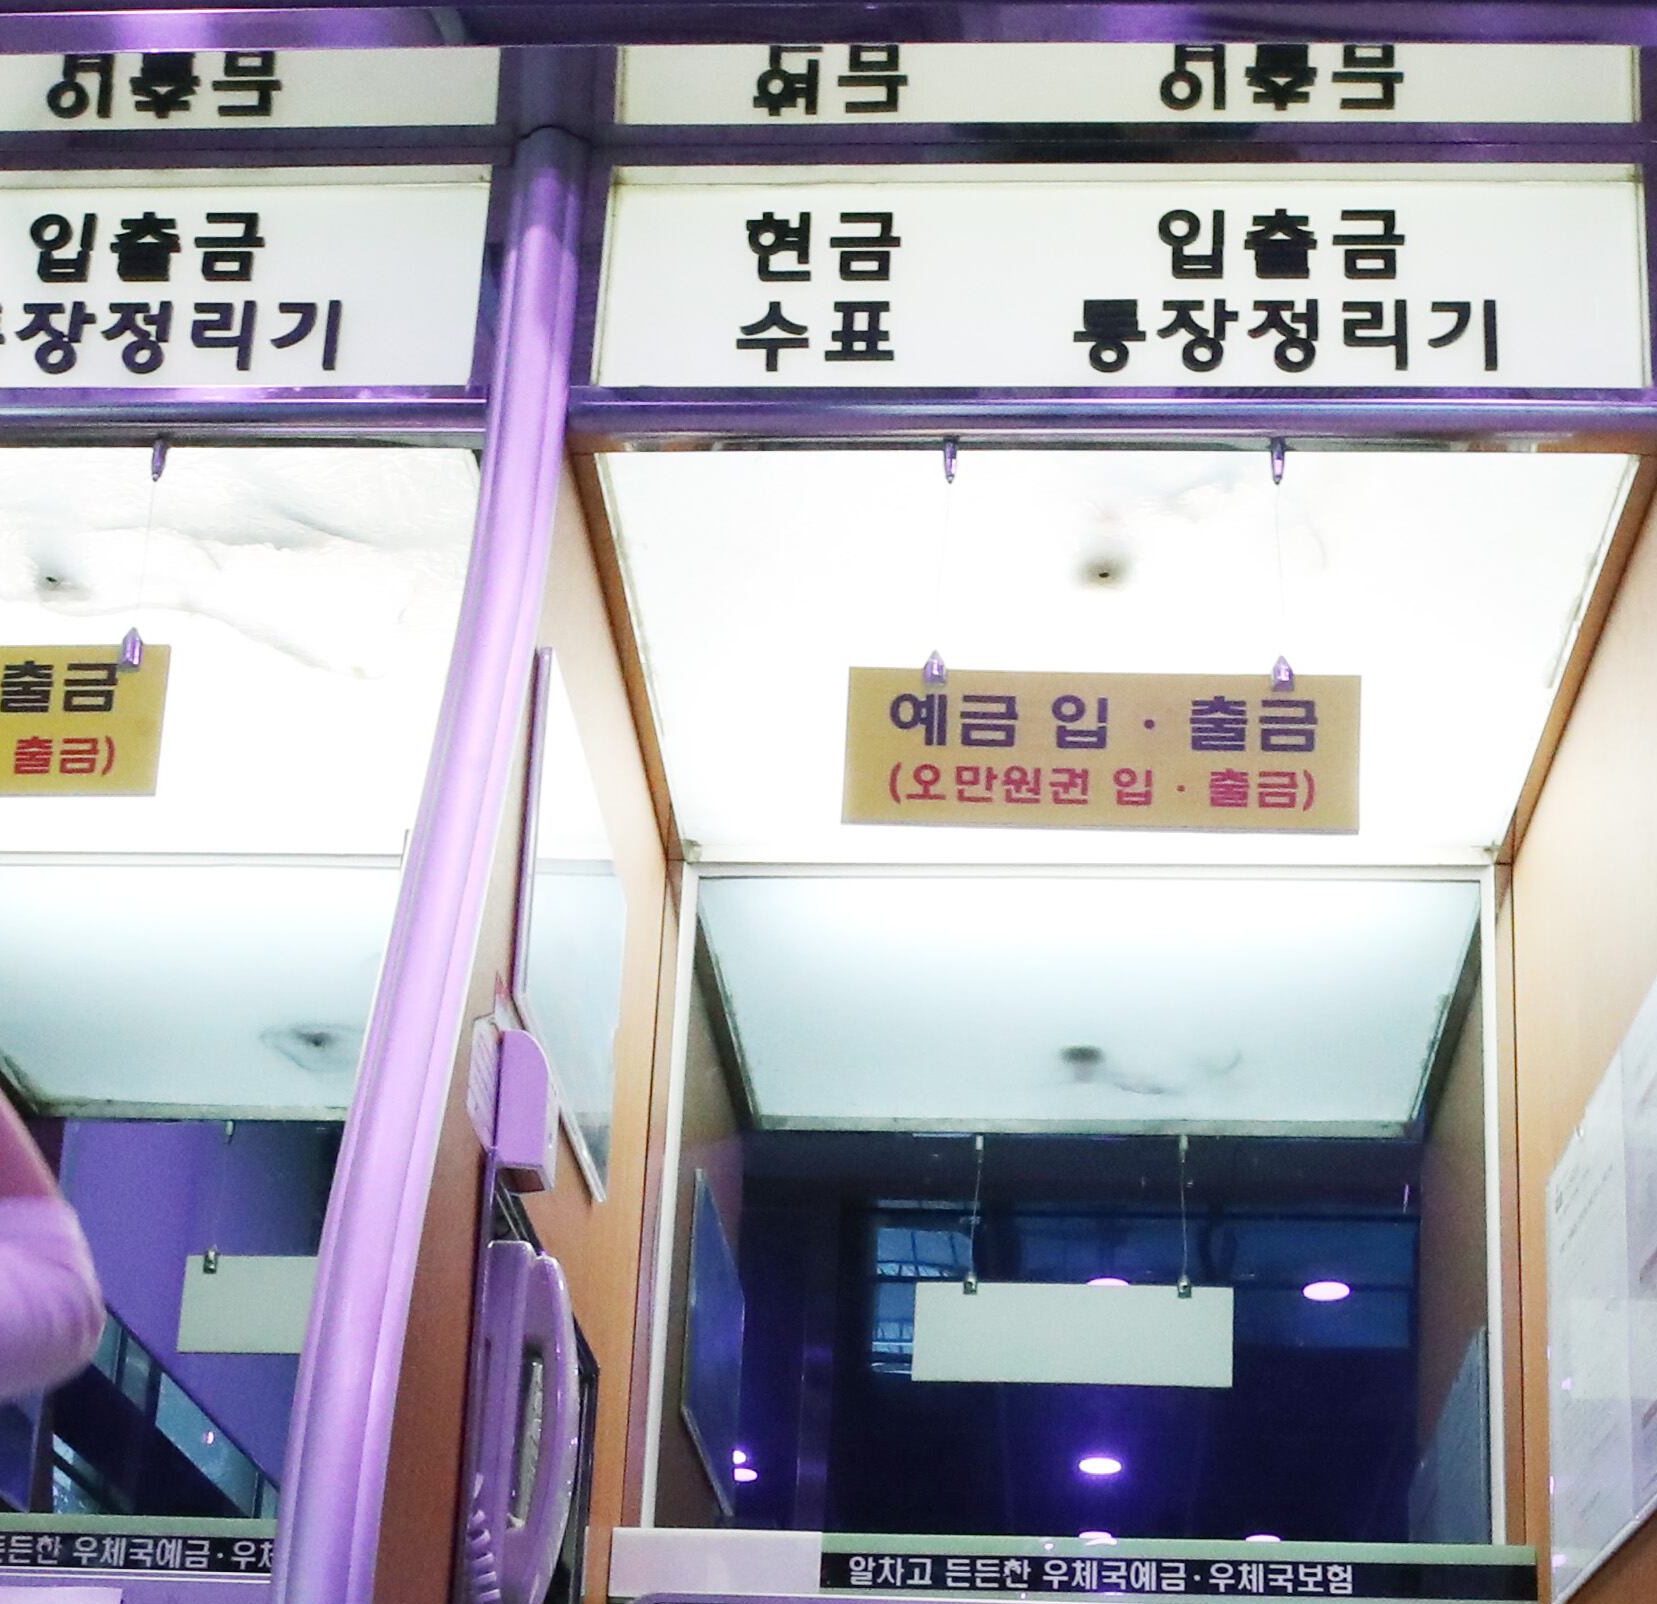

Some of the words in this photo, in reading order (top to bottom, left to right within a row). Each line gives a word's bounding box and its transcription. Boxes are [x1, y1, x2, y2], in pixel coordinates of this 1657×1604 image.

[30, 211, 267, 283] 입출금
[746, 211, 902, 281] 현금
[1158, 208, 1405, 279] 입출금
[736, 300, 896, 372] 수표
[1073, 298, 1498, 373] 통장정리기
[890, 693, 1019, 747] 예금
[890, 762, 1090, 805] (오만원권
[849, 1556, 933, 1586] 알차고
[945, 1559, 1031, 1589] 든든한
